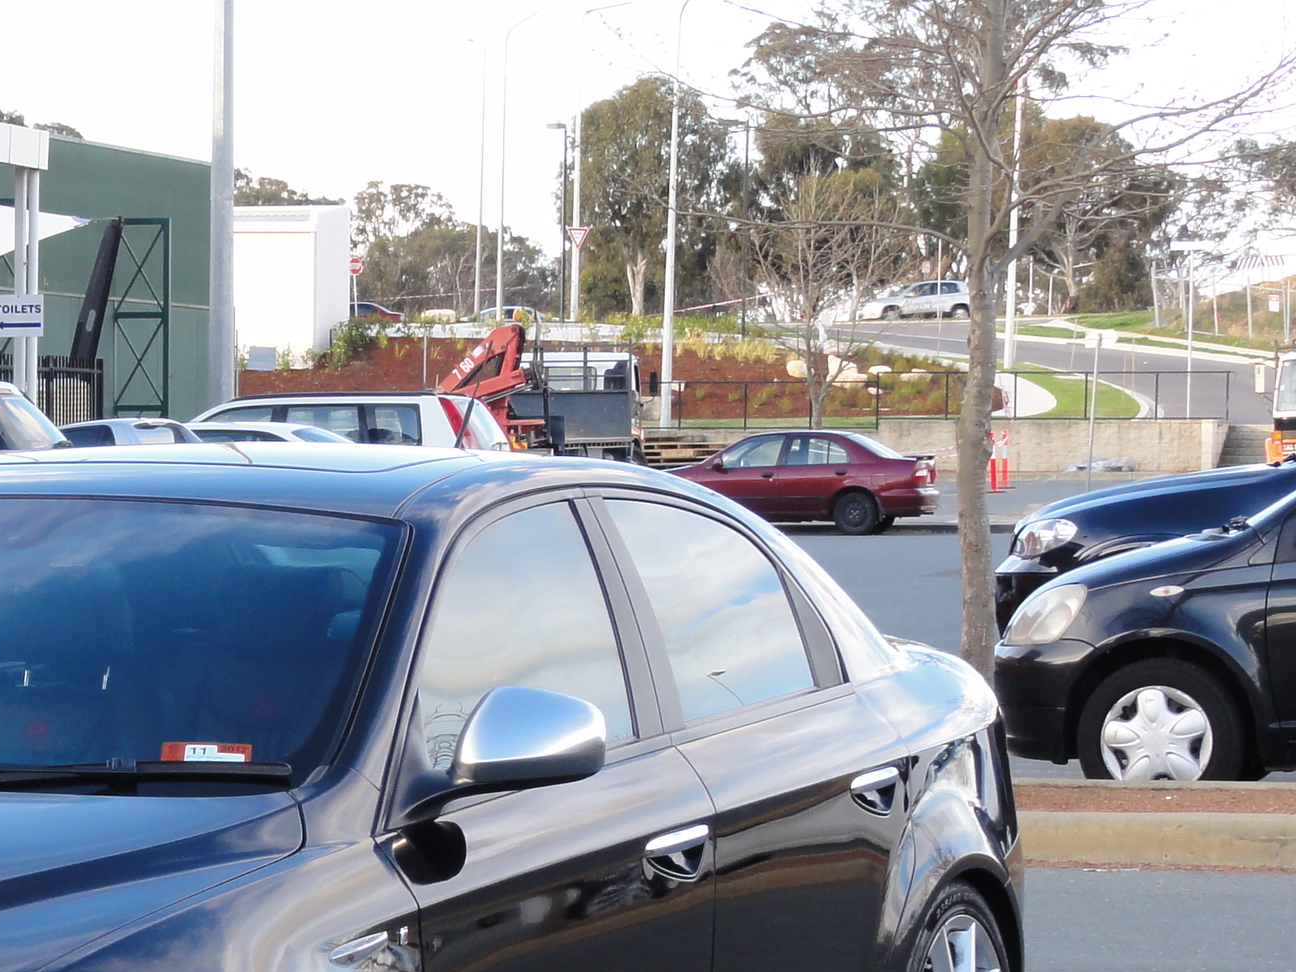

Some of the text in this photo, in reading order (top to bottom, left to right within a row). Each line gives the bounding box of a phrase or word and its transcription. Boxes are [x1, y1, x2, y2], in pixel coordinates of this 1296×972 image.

[451, 357, 475, 380] 7 60
[190, 746, 207, 756] 11
